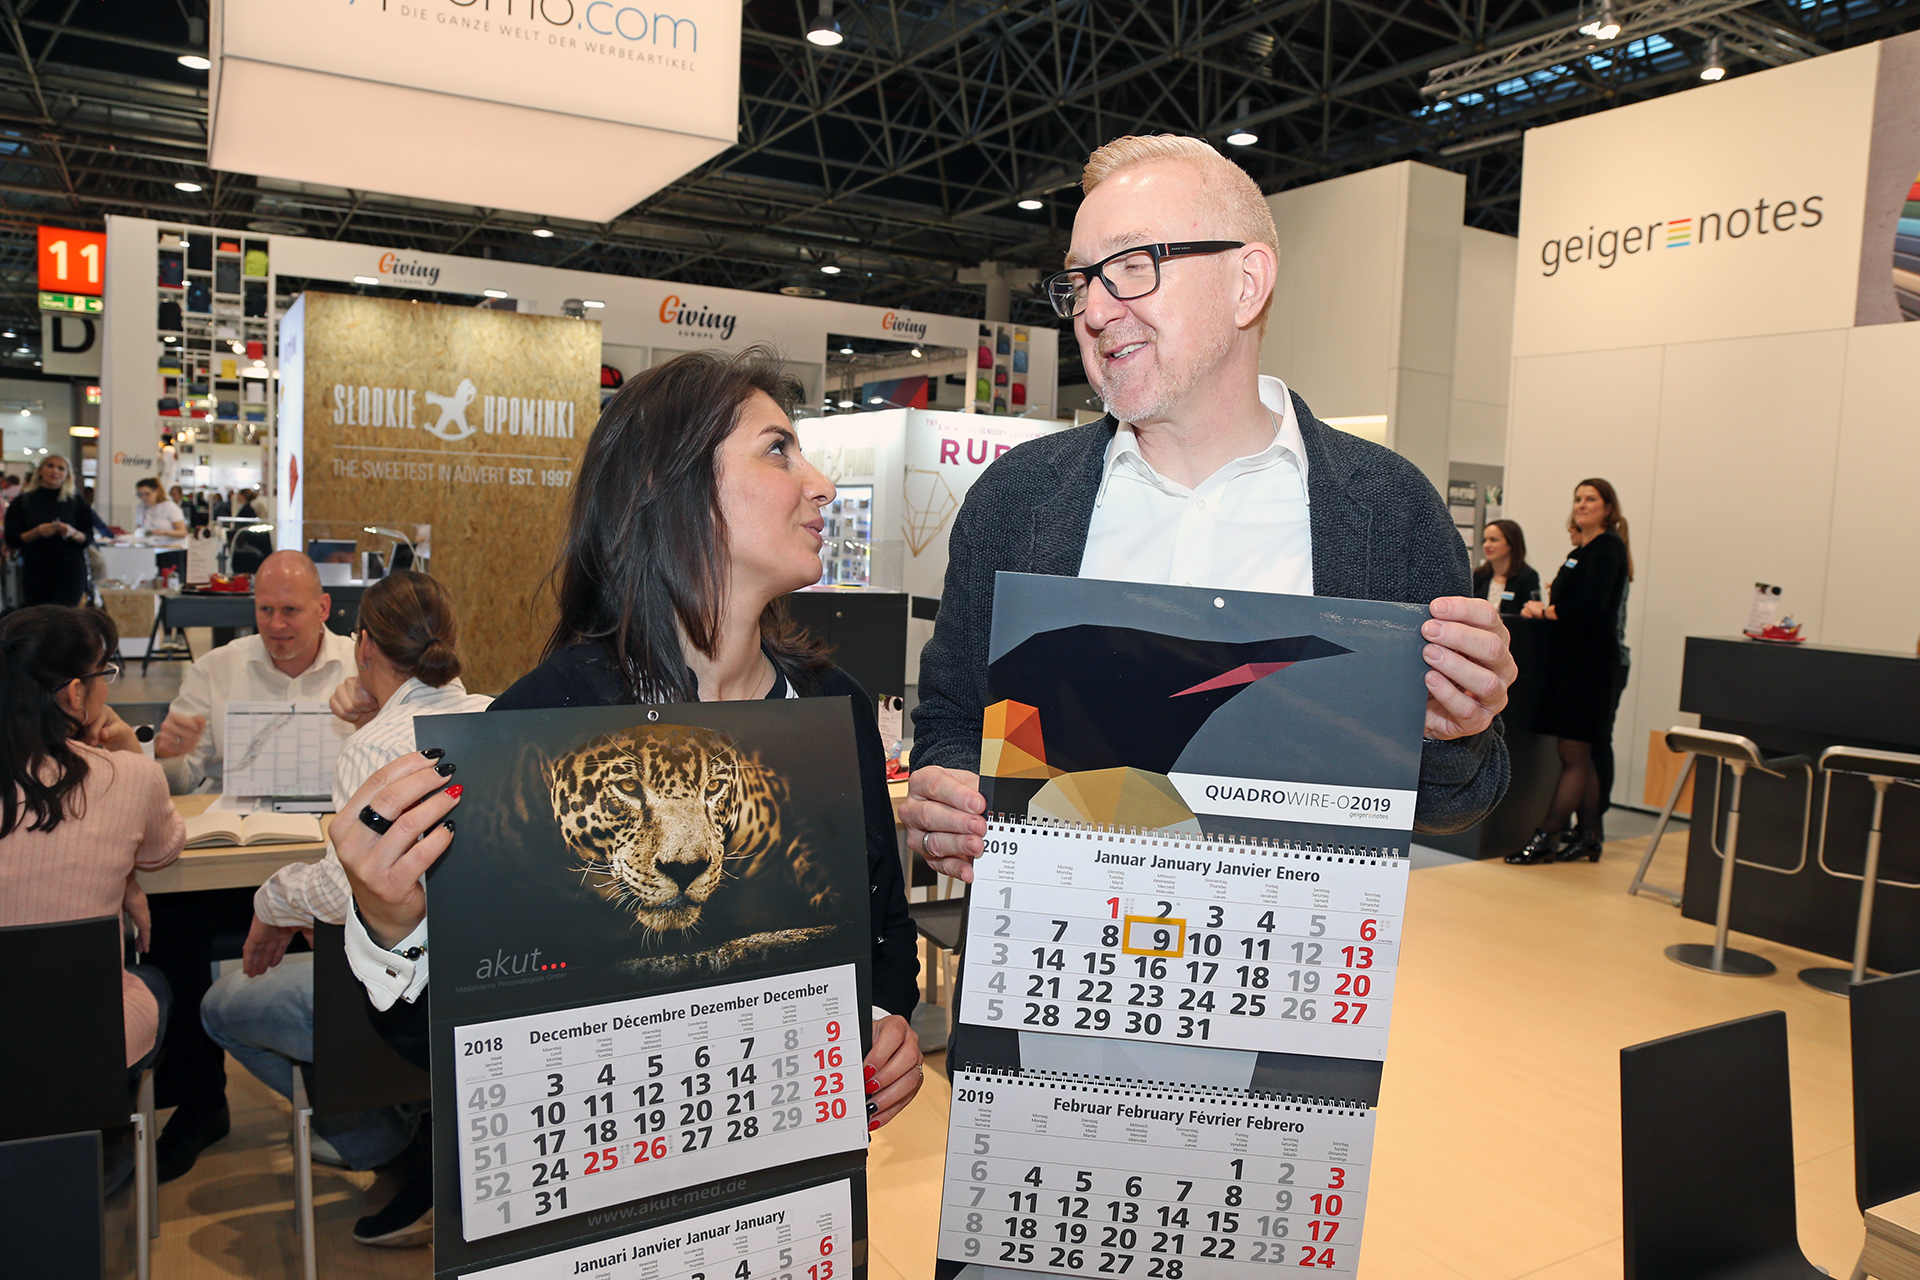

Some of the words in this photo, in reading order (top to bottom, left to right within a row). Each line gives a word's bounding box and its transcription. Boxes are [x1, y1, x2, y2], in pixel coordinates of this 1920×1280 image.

[400, 4, 428, 20] DIE
[437, 13, 491, 33] GANZE
[499, 24, 540, 42] WELT
[548, 33, 577, 49] DER
[584, 41, 696, 73] WERBEARTIKEL
[48, 240, 99, 283] 11
[378, 252, 441, 287] Giving
[51, 316, 96, 354] D
[658, 294, 737, 340] Giving
[678, 330, 714, 340] EUROPE
[881, 311, 927, 340] Giving
[333, 384, 417, 430] SŁODKIE
[483, 395, 575, 439] UPOMINKI
[113, 451, 153, 469] Giving
[333, 458, 360, 478] THE
[361, 459, 435, 482] SWEETEST
[437, 462, 452, 481] IN
[452, 463, 506, 485] ADVERT
[508, 468, 536, 486] EST.
[541, 469, 573, 487] 1997
[983, 839, 1018, 857] 2019
[1094, 849, 1147, 869] Januar
[1150, 854, 1211, 876] January
[1215, 859, 1273, 880] Janvier
[1276, 866, 1321, 883] Enero
[999, 887, 1012, 909] 1
[1107, 897, 1120, 920] 1
[1156, 901, 1173, 918] 2
[1206, 906, 1224, 928] 3
[1257, 910, 1276, 933] 4
[1309, 915, 1327, 938] 5
[1360, 918, 1377, 942] 6
[993, 915, 1011, 938] 2
[1051, 920, 1069, 943] 7
[1101, 924, 1119, 948] 8
[1153, 928, 1171, 951] 9
[1188, 932, 1222, 957] 10
[1239, 937, 1271, 962] 11
[1291, 941, 1323, 965] 12
[1341, 945, 1374, 970] 13
[991, 943, 1009, 966] 3
[1032, 946, 1066, 971] 14
[1083, 951, 1117, 976] 15
[1133, 955, 1168, 981] 16
[1184, 960, 1219, 985] 17
[1236, 965, 1270, 990] 18
[1288, 970, 1321, 995] 19
[1333, 973, 1371, 998] 20
[530, 1021, 608, 1045] December
[613, 1009, 686, 1031] Décembre
[690, 993, 759, 1017] Dezember
[763, 983, 829, 1005] December
[986, 999, 1004, 1021] 5
[1023, 1002, 1060, 1027] 28
[1073, 1006, 1111, 1032] 29
[1124, 1011, 1163, 1036] 30
[1176, 1015, 1211, 1041] 31
[464, 1037, 504, 1057] 2018
[468, 1083, 507, 1111] 49
[547, 1073, 565, 1098] 3
[597, 1063, 616, 1086] 4
[648, 1054, 664, 1078] 5
[694, 1045, 711, 1068] 6
[739, 1037, 755, 1060] 7
[784, 1028, 799, 1051] 8
[825, 1020, 841, 1042] 9
[471, 1112, 509, 1142] 50
[530, 1101, 566, 1128] 10
[583, 1091, 614, 1117] 11
[632, 1082, 665, 1108] 12
[680, 1072, 711, 1098] 13
[726, 1063, 758, 1088] 14
[771, 1054, 800, 1079] 15
[813, 1046, 843, 1070] 16
[958, 1087, 995, 1105] 2019
[1053, 1097, 1113, 1116] Februar
[1116, 1103, 1185, 1126] February
[1188, 1109, 1243, 1128] Février
[1246, 1114, 1306, 1134] Febrero
[474, 1142, 508, 1172] 51
[533, 1128, 566, 1157] 17
[583, 1119, 618, 1146] 18
[633, 1109, 666, 1135] 19
[679, 1099, 713, 1126] 20
[726, 1090, 755, 1116] 21
[771, 1080, 801, 1106] 22
[813, 1072, 845, 1097] 23
[475, 1171, 512, 1202] 52
[531, 1157, 569, 1188] 24
[583, 1146, 619, 1176] 25
[633, 1136, 668, 1164] 26
[681, 1125, 713, 1153] 27
[727, 1115, 759, 1143] 28
[772, 1106, 803, 1132] 29
[815, 1098, 847, 1123] 30
[973, 1133, 990, 1155] 5
[1230, 1158, 1244, 1181] 1
[1277, 1162, 1295, 1185] 2
[1327, 1166, 1346, 1190] 3
[497, 1201, 511, 1225] 1
[535, 1186, 568, 1217] 31
[587, 1177, 747, 1228] www.akut-med.de
[970, 1160, 988, 1182] 6
[1023, 1166, 1043, 1188] 4
[1075, 1170, 1093, 1193] 5
[1125, 1175, 1143, 1198] 6
[1176, 1180, 1193, 1202] 7
[1224, 1185, 1243, 1207] 8
[1275, 1189, 1293, 1212] 9
[1309, 1193, 1343, 1217] 10
[573, 1248, 627, 1275] Januari
[631, 1236, 682, 1260] Janvier
[686, 1223, 731, 1246] Januar
[734, 1209, 786, 1232] January
[734, 1259, 752, 1280] 4
[779, 1247, 793, 1270] 5
[819, 1235, 834, 1257] 6
[807, 1260, 834, 1280] 13
